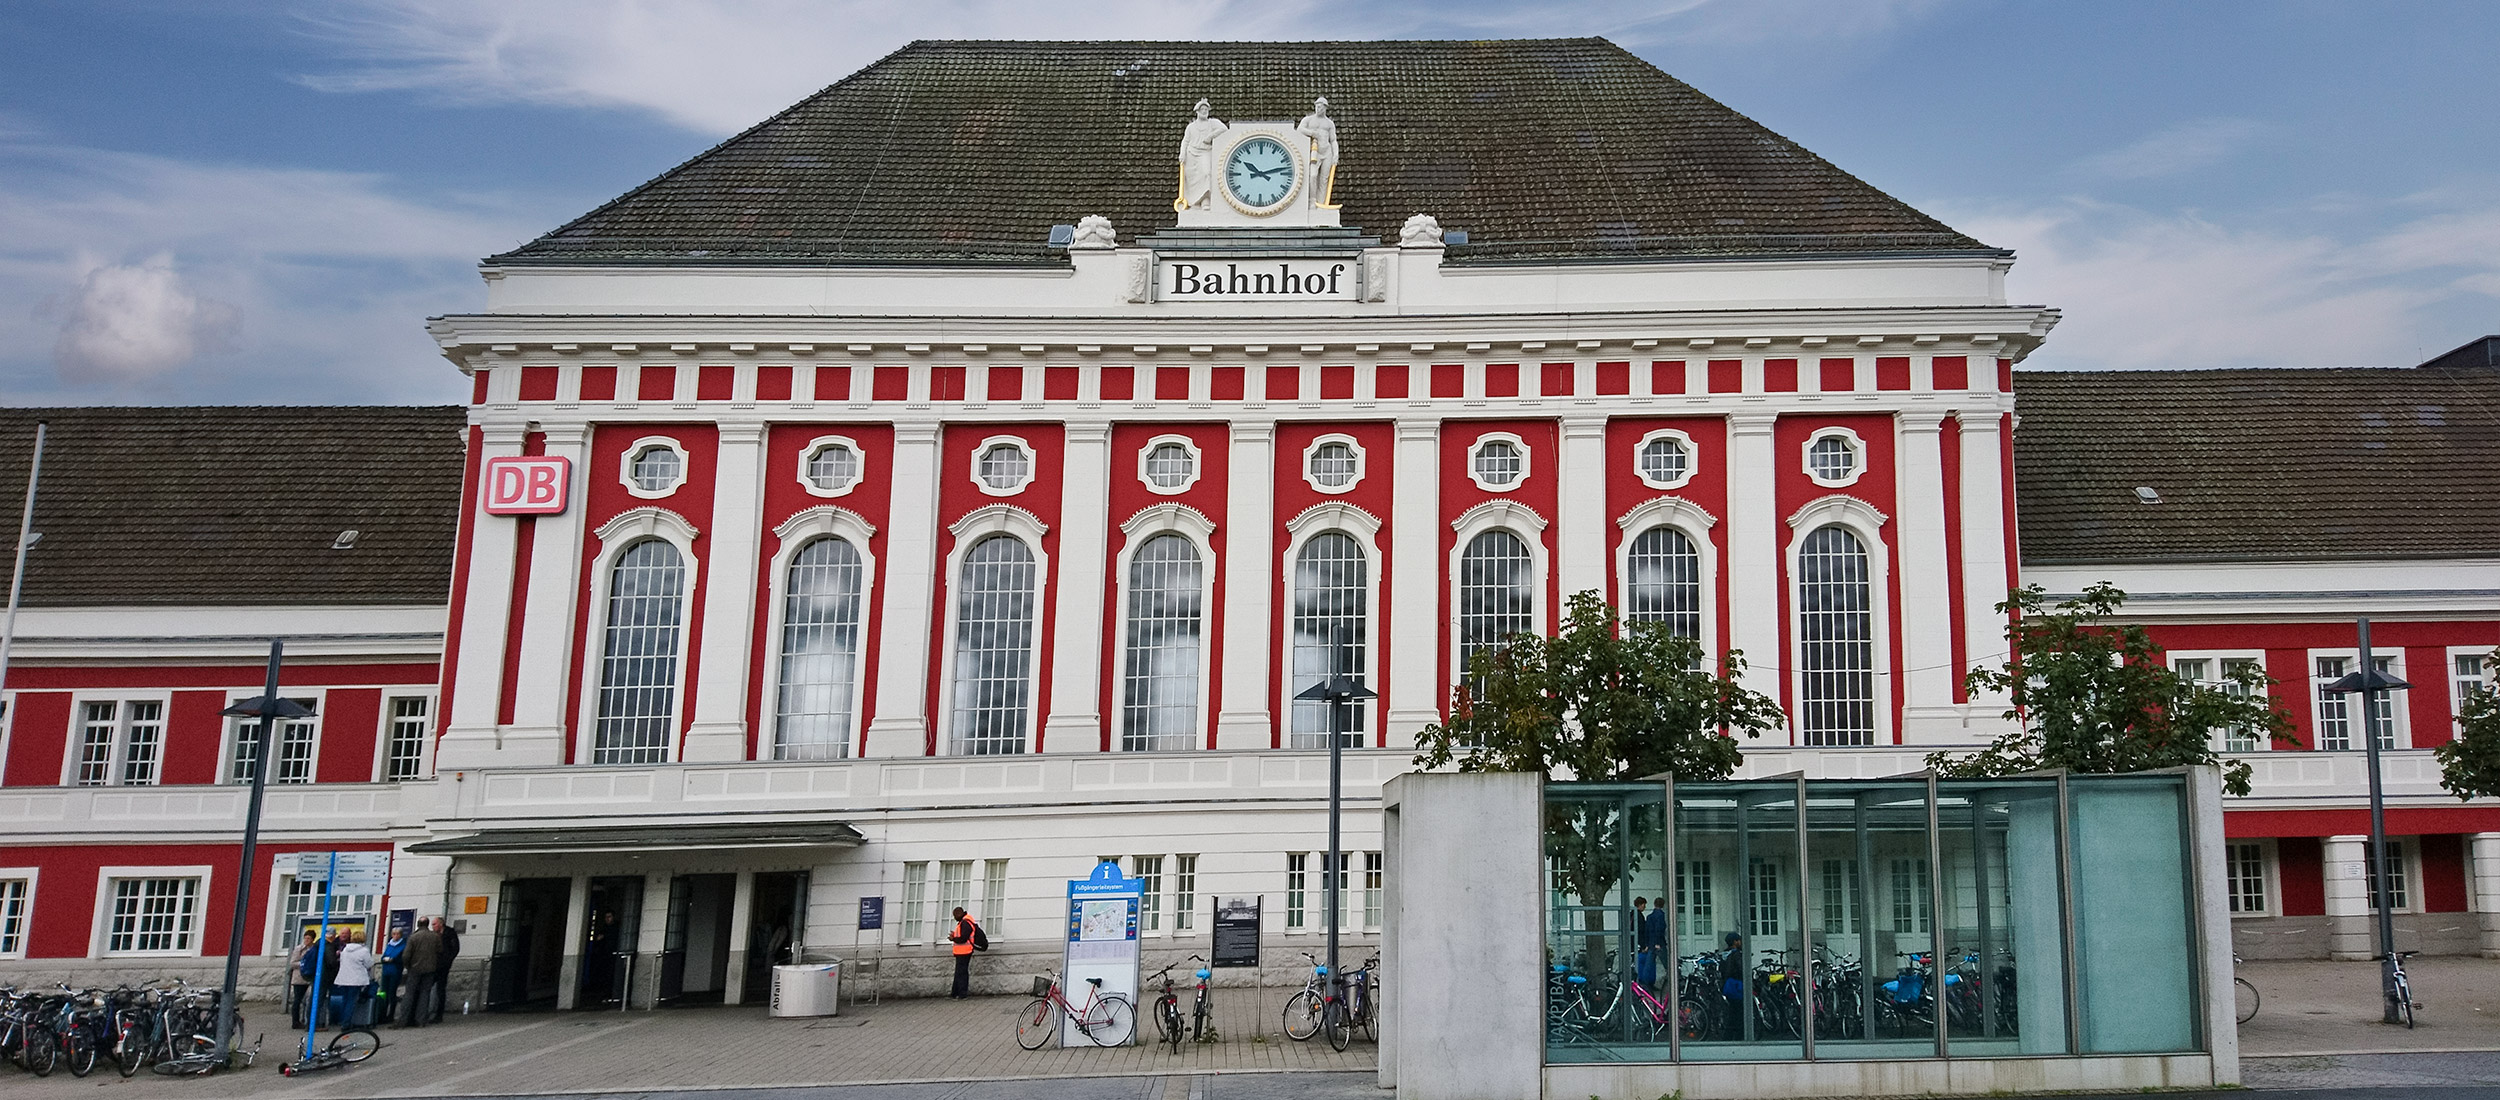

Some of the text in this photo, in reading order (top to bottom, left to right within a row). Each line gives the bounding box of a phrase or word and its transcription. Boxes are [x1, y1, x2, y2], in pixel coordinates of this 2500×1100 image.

[1171, 263, 1345, 295] Bahnhof
[494, 466, 556, 504] DB
[772, 981, 781, 1010] Abfall
